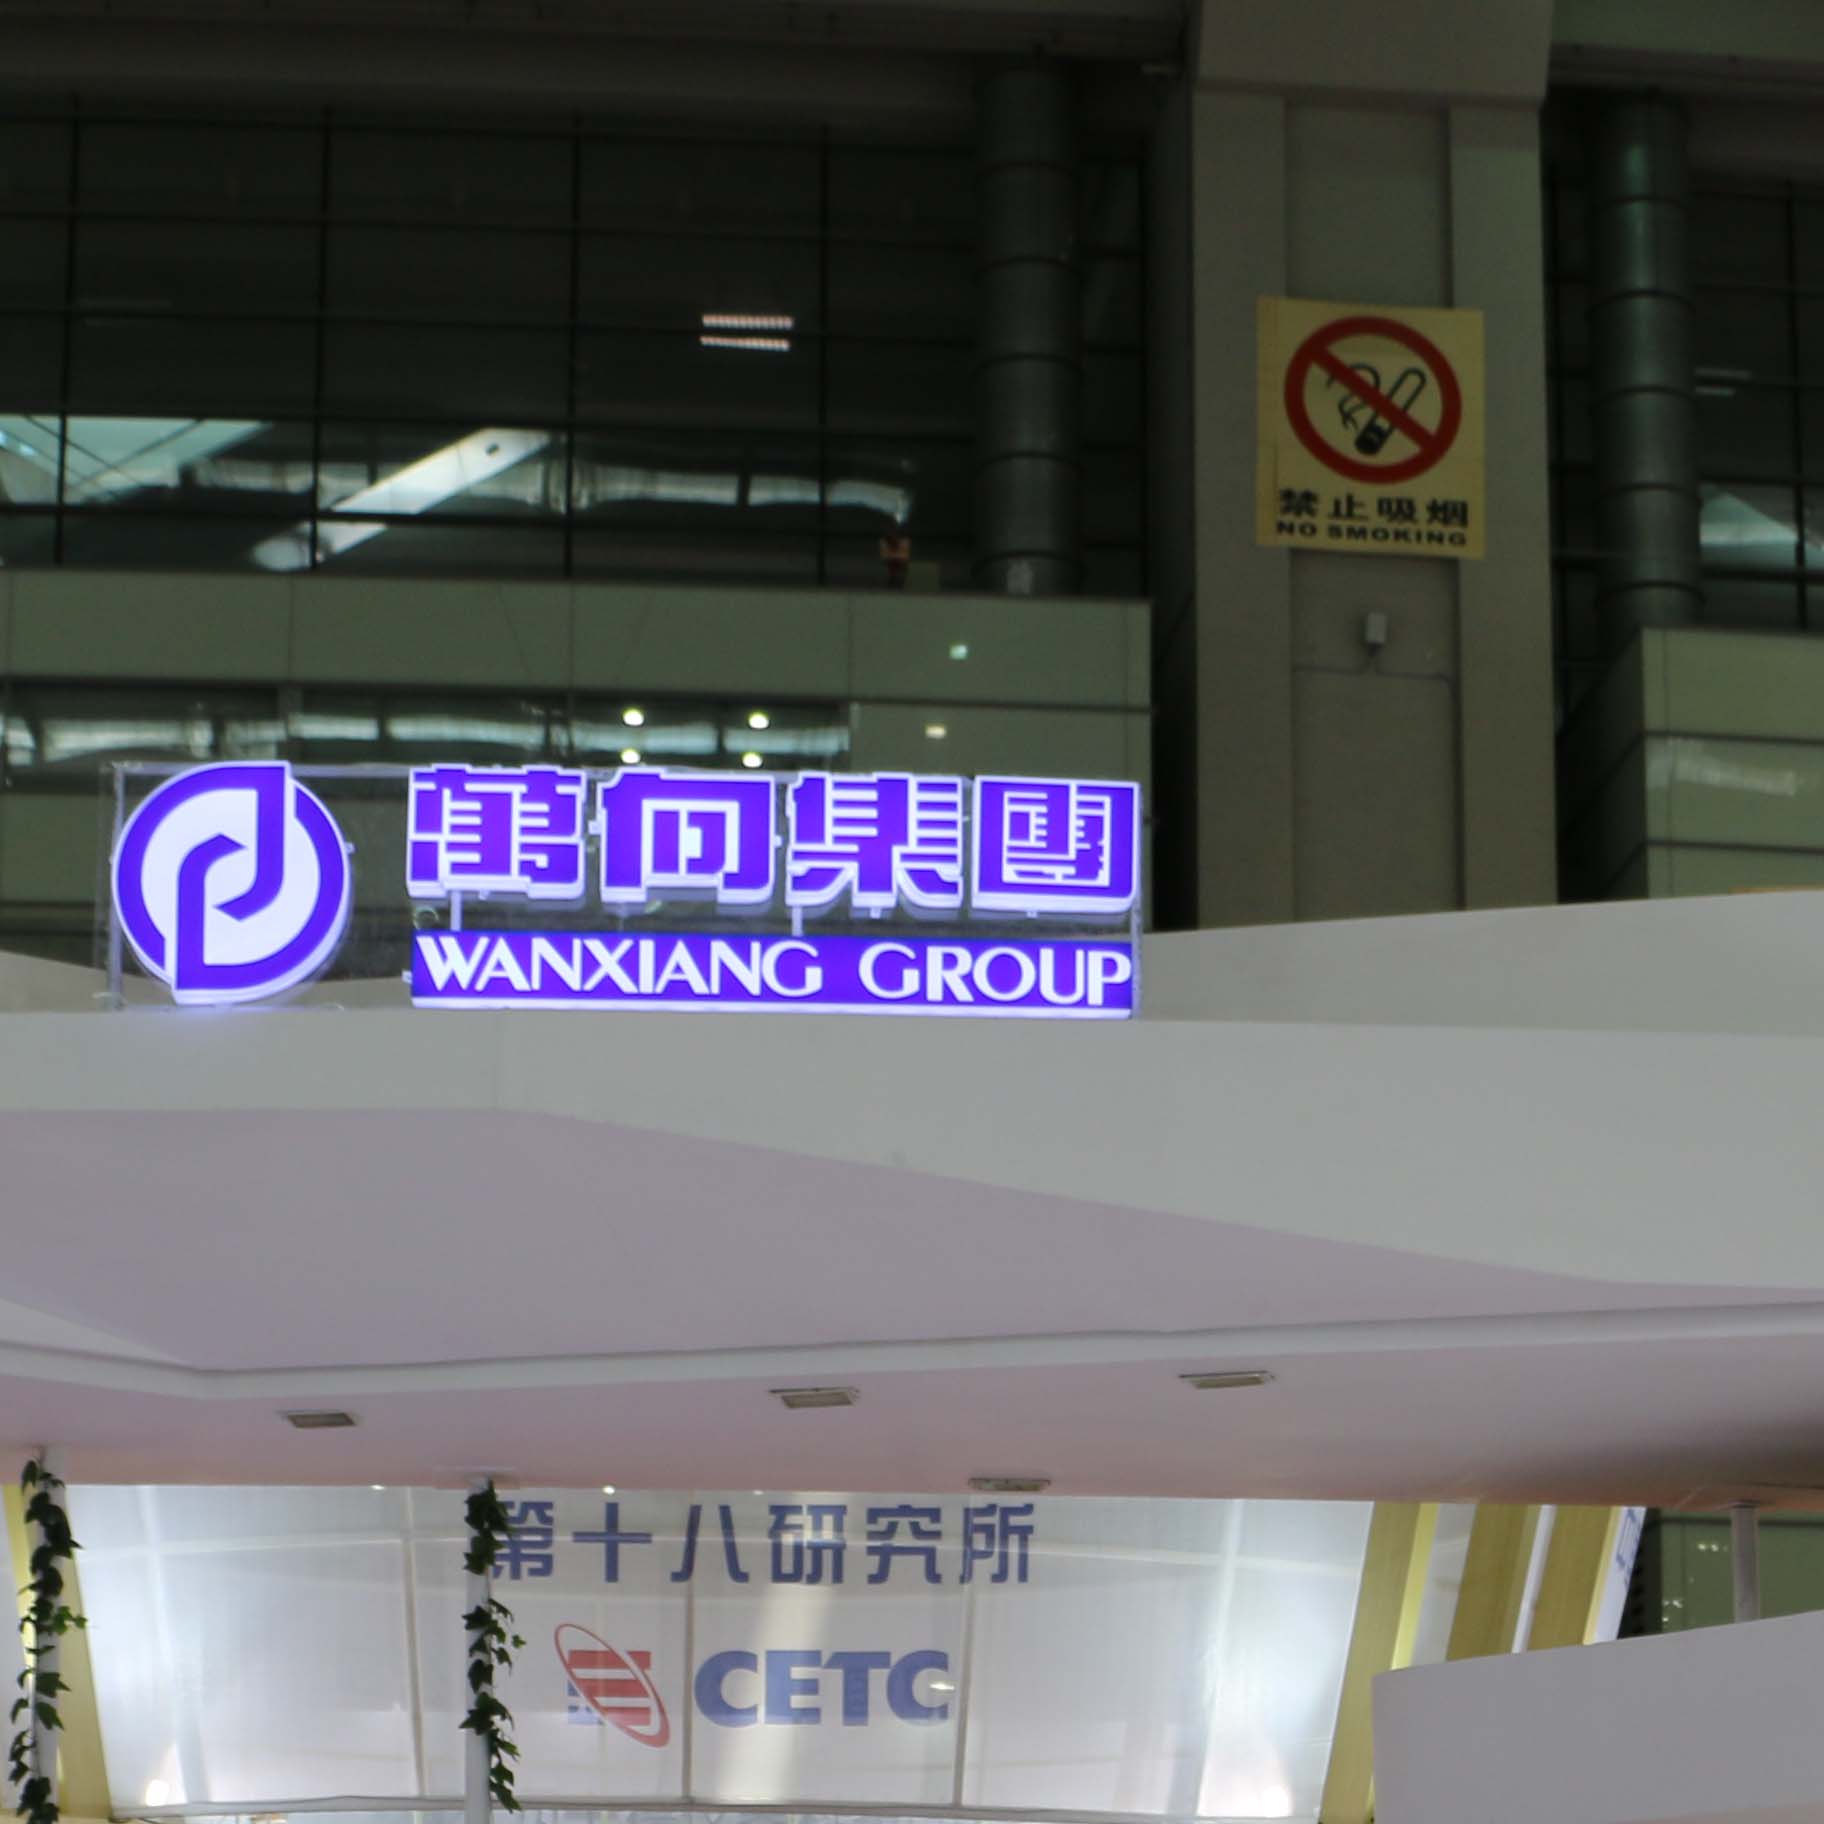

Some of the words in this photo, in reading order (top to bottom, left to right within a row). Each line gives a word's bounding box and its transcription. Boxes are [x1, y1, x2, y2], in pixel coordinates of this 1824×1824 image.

[1277, 521, 1317, 537] NO
[1328, 525, 1467, 545] SMOKING
[1279, 488, 1468, 528] 禁止吸烟
[417, 934, 822, 998] WANXIANG
[858, 940, 1132, 1006] GROUP
[493, 1500, 1034, 1585] 第十八研究所
[694, 1649, 950, 1727] CETC
